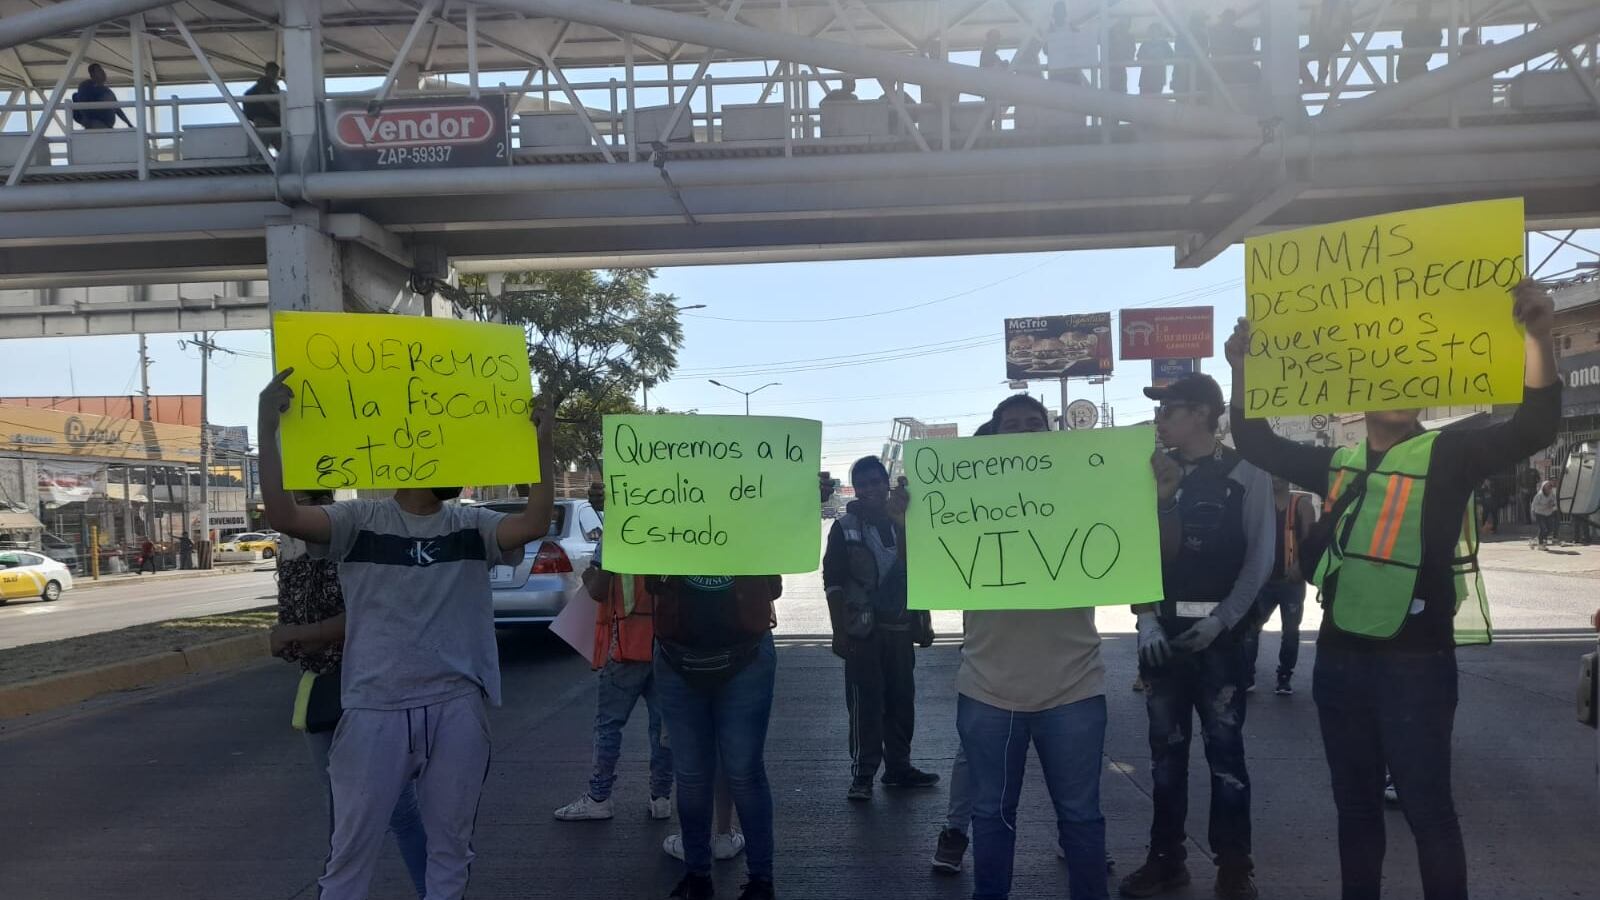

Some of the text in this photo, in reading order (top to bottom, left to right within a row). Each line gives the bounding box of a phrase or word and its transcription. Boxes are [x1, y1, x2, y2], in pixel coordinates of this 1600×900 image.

[353, 113, 475, 142] Vendor
[377, 146, 452, 165] ZAP-59337
[1250, 225, 1414, 285] NO MAS
[1008, 319, 1048, 330] McTrio
[300, 379, 327, 420] A
[346, 379, 381, 420] la
[393, 417, 444, 449] del
[615, 424, 804, 466] Queremos a la
[915, 447, 1105, 484] Queremos a
[610, 472, 763, 507] Fiscalia del
[922, 491, 1055, 528] Pechocho
[621, 514, 729, 546] Estado
[938, 522, 1121, 590] VIVO
